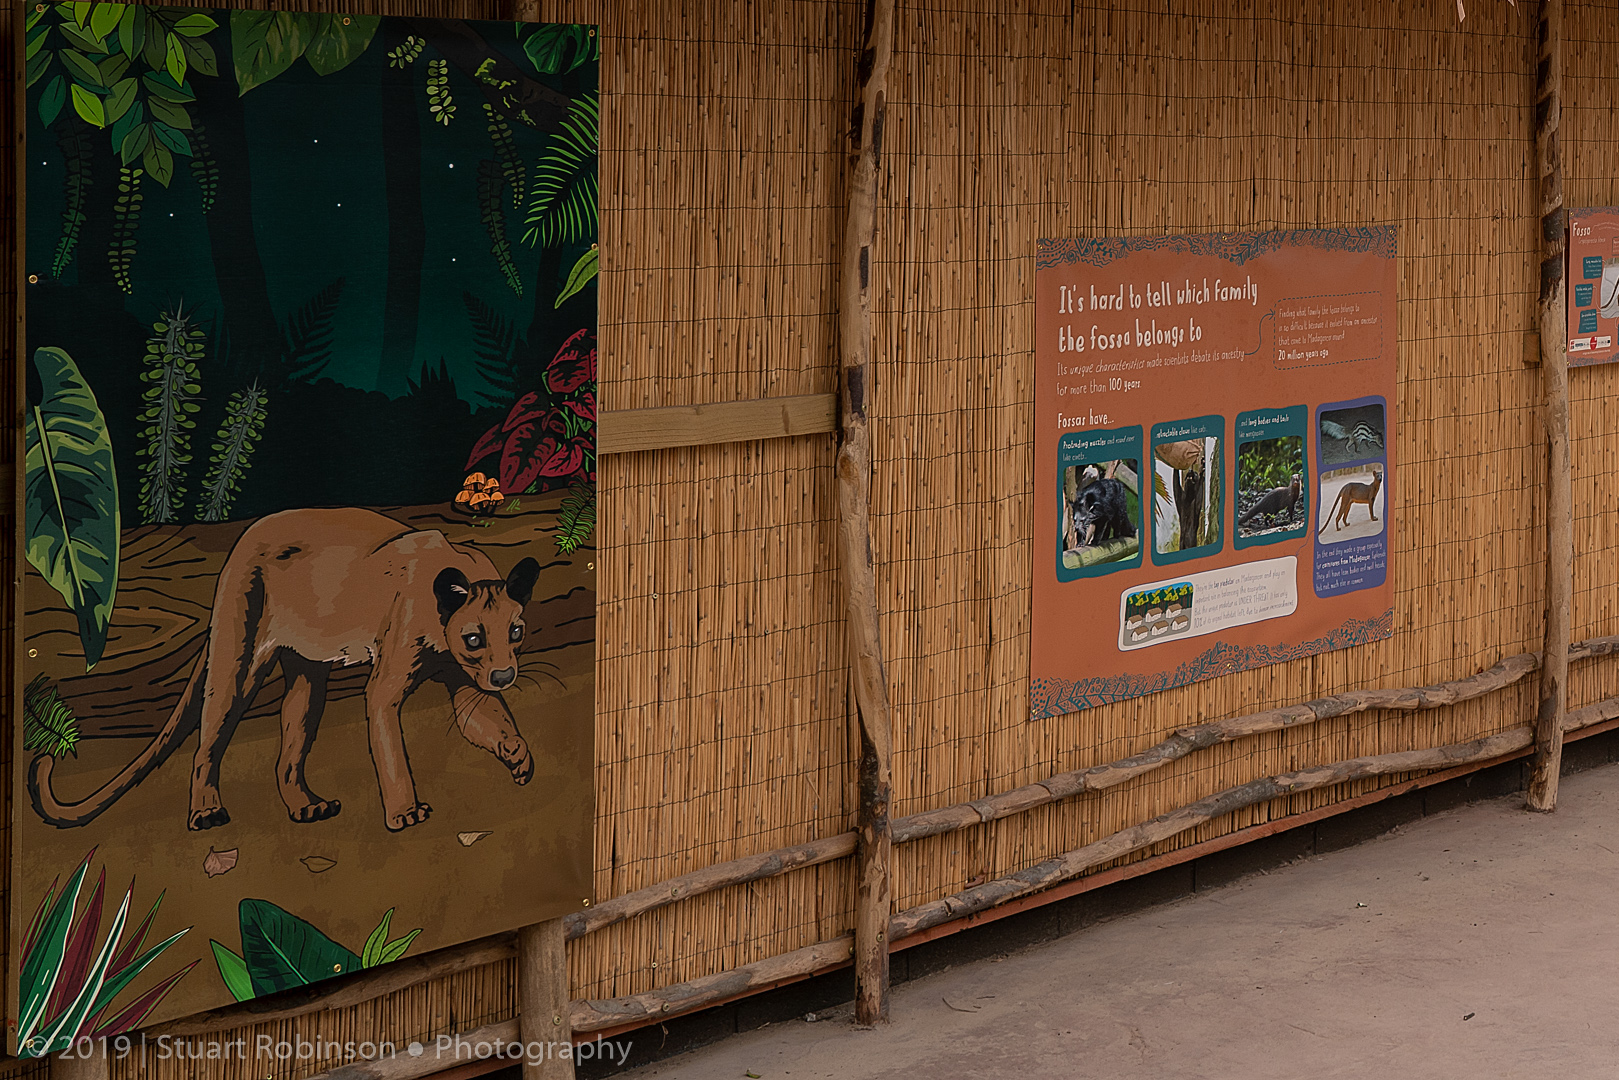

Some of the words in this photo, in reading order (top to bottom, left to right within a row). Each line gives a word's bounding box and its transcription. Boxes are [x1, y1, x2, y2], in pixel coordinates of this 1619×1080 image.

[1059, 284, 1084, 314] It's
[1090, 283, 1123, 311] hard
[1129, 284, 1142, 309] to
[1146, 282, 1172, 308] tell
[1176, 277, 1210, 306] which
[1214, 275, 1258, 306] family
[1059, 324, 1085, 353] the
[1090, 324, 1130, 350] fossa
[1135, 317, 1184, 348] belongs
[1189, 317, 1202, 342] to
[1057, 362, 1068, 376] Its
[1069, 363, 1094, 377] unique
[1095, 358, 1145, 373] characteristics
[1146, 353, 1163, 368] made
[1190, 349, 1211, 363] debate
[1212, 350, 1220, 362] its
[1221, 346, 1245, 362] ancestry
[1278, 349, 1286, 361] 20
[1287, 348, 1305, 360] million
[1305, 350, 1319, 361] years
[1056, 382, 1068, 396] for
[1070, 384, 1087, 395] more
[1090, 378, 1107, 394] than
[1108, 377, 1122, 391] 100
[1057, 412, 1086, 429] Fossas
